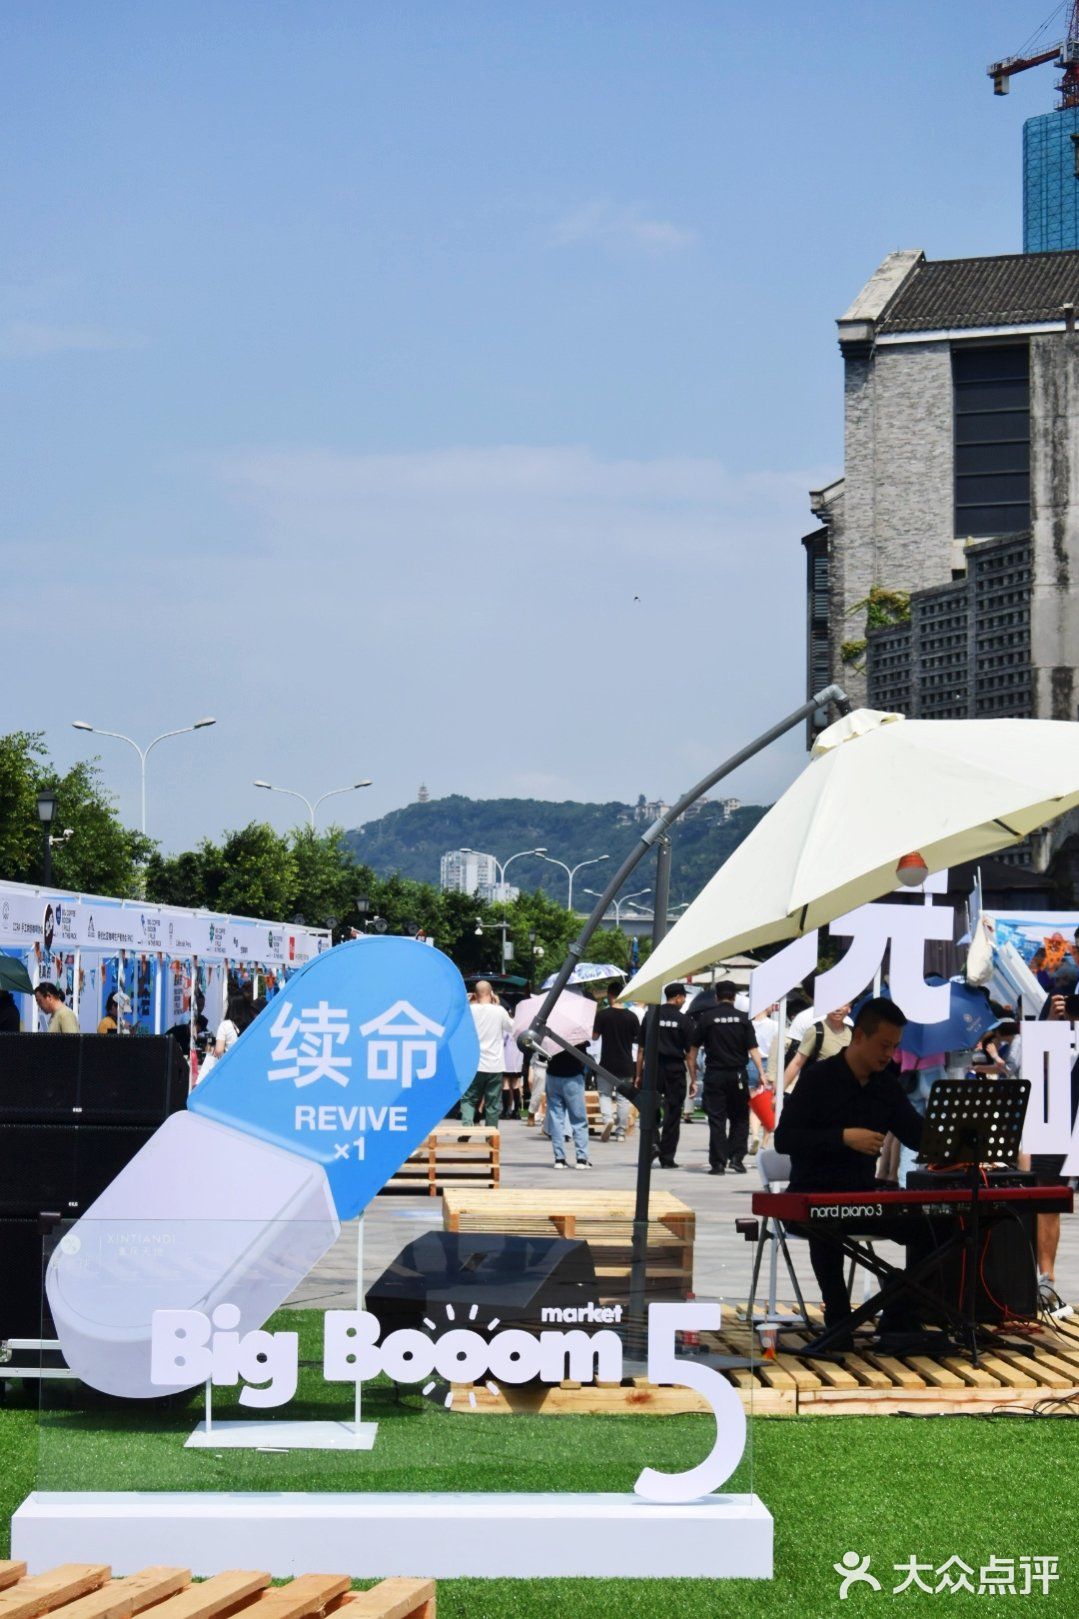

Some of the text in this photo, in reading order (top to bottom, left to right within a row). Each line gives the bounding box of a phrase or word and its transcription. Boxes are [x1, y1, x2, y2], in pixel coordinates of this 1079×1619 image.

[267, 1000, 446, 1088] 续命
[294, 1105, 408, 1132] REVIVE
[810, 1203, 883, 1219] nord piano 3
[107, 1233, 176, 1245] XINTIANDI
[541, 1303, 623, 1324] market
[150, 1303, 623, 1409] Big Booom
[633, 1302, 747, 1503] 5
